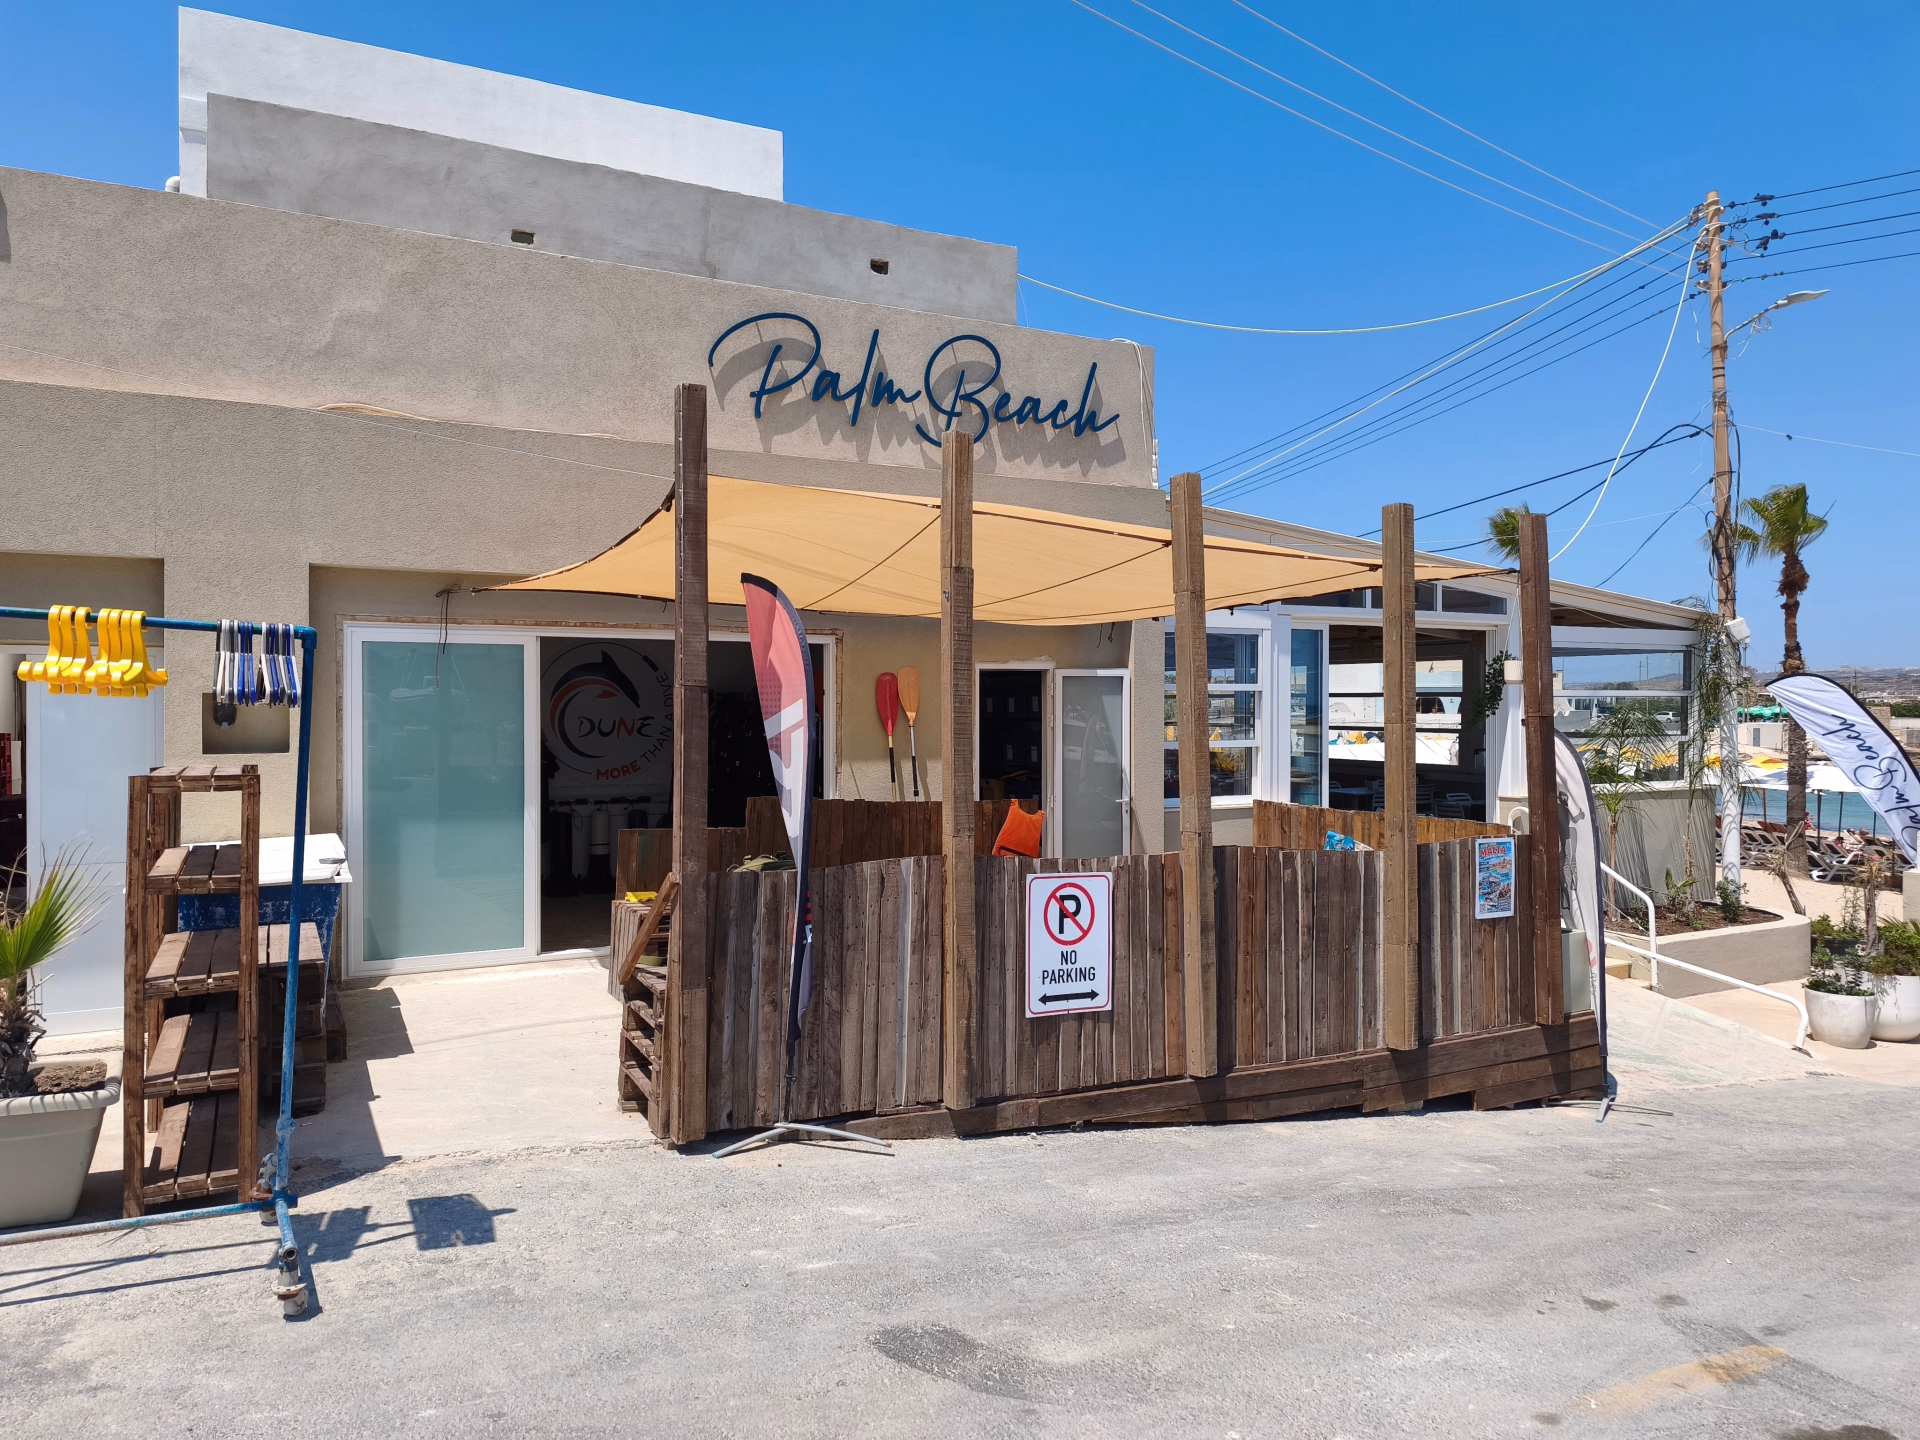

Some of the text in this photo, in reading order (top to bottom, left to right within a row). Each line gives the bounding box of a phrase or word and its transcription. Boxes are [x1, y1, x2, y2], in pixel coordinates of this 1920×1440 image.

[708, 312, 1120, 447] Palm Beach
[655, 672, 674, 707] DIVE
[577, 715, 655, 739] DUNE
[640, 726, 673, 763] THAN
[1822, 714, 1907, 790] Beach
[596, 760, 641, 780] MORE
[1480, 846, 1507, 858] MALTA
[1060, 950, 1077, 966] NO
[1042, 966, 1096, 986] PARKING
